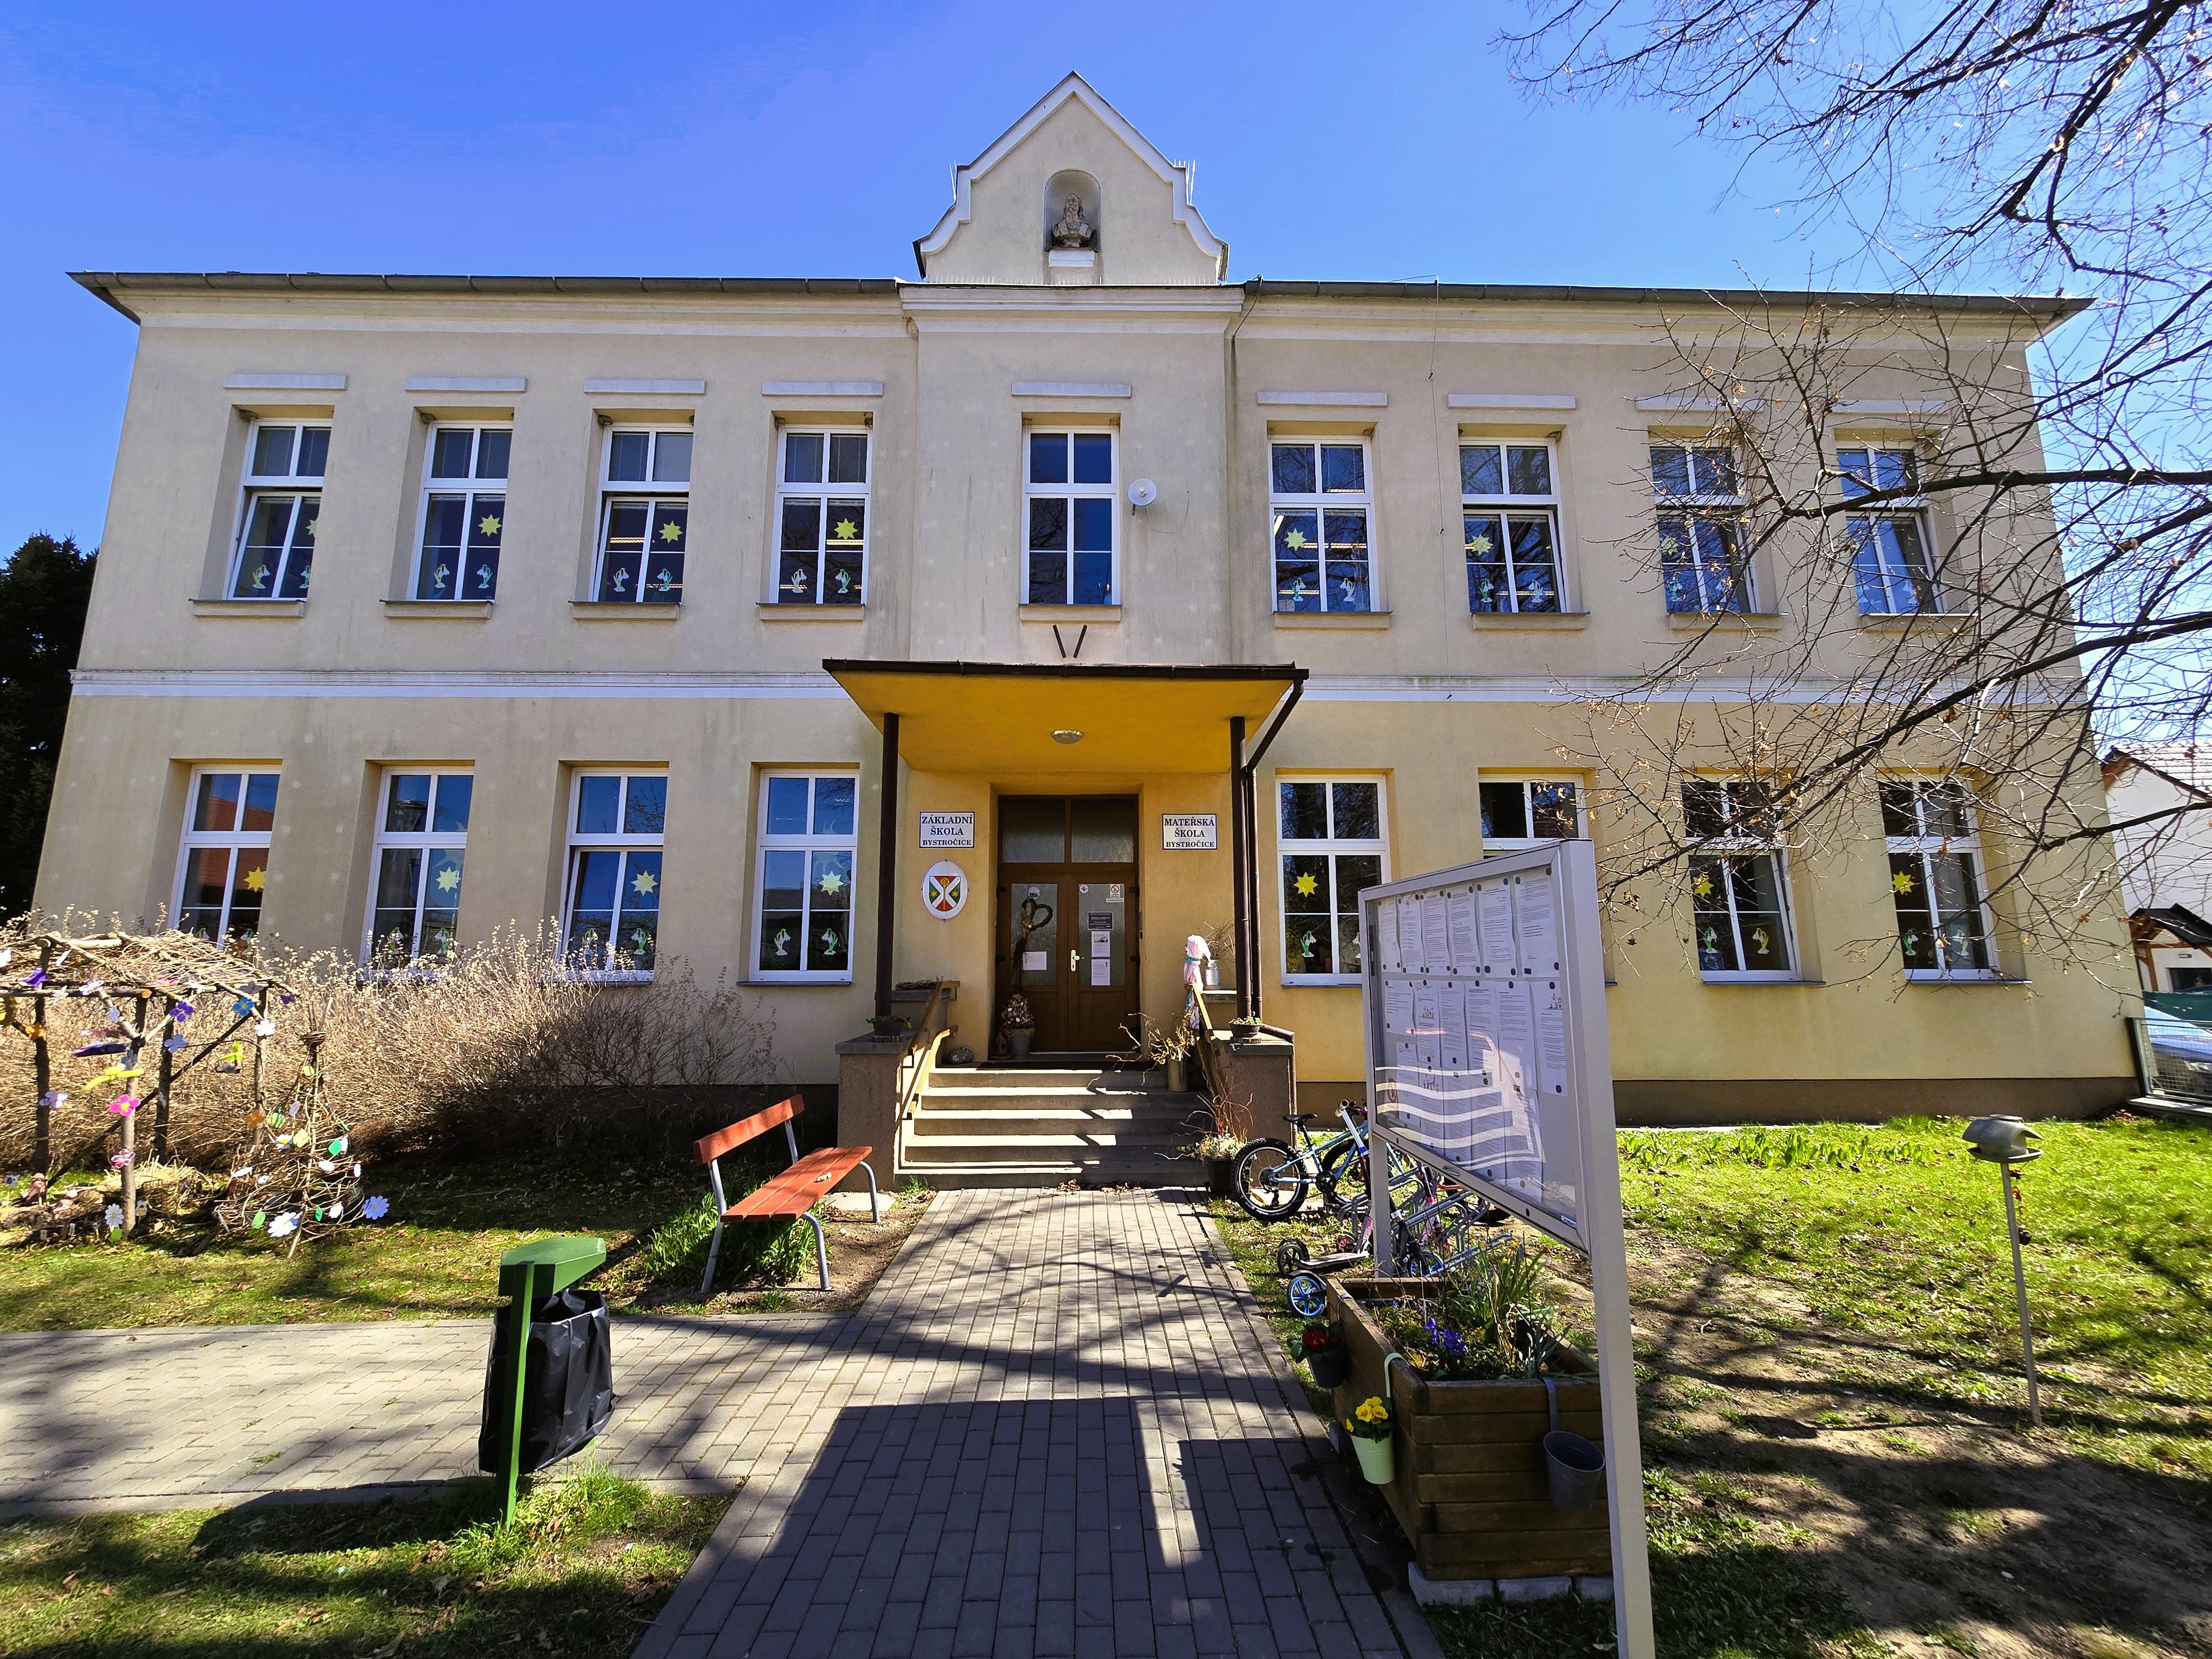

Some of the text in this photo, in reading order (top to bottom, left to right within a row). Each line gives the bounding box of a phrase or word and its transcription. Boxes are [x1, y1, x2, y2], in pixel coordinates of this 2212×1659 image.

[921, 814, 973, 824] ZÁKLADNÍ
[1164, 816, 1214, 826] MATEŘSKÁ
[930, 825, 964, 835] ŠKOLA
[1175, 827, 1205, 837] ŠKOLA
